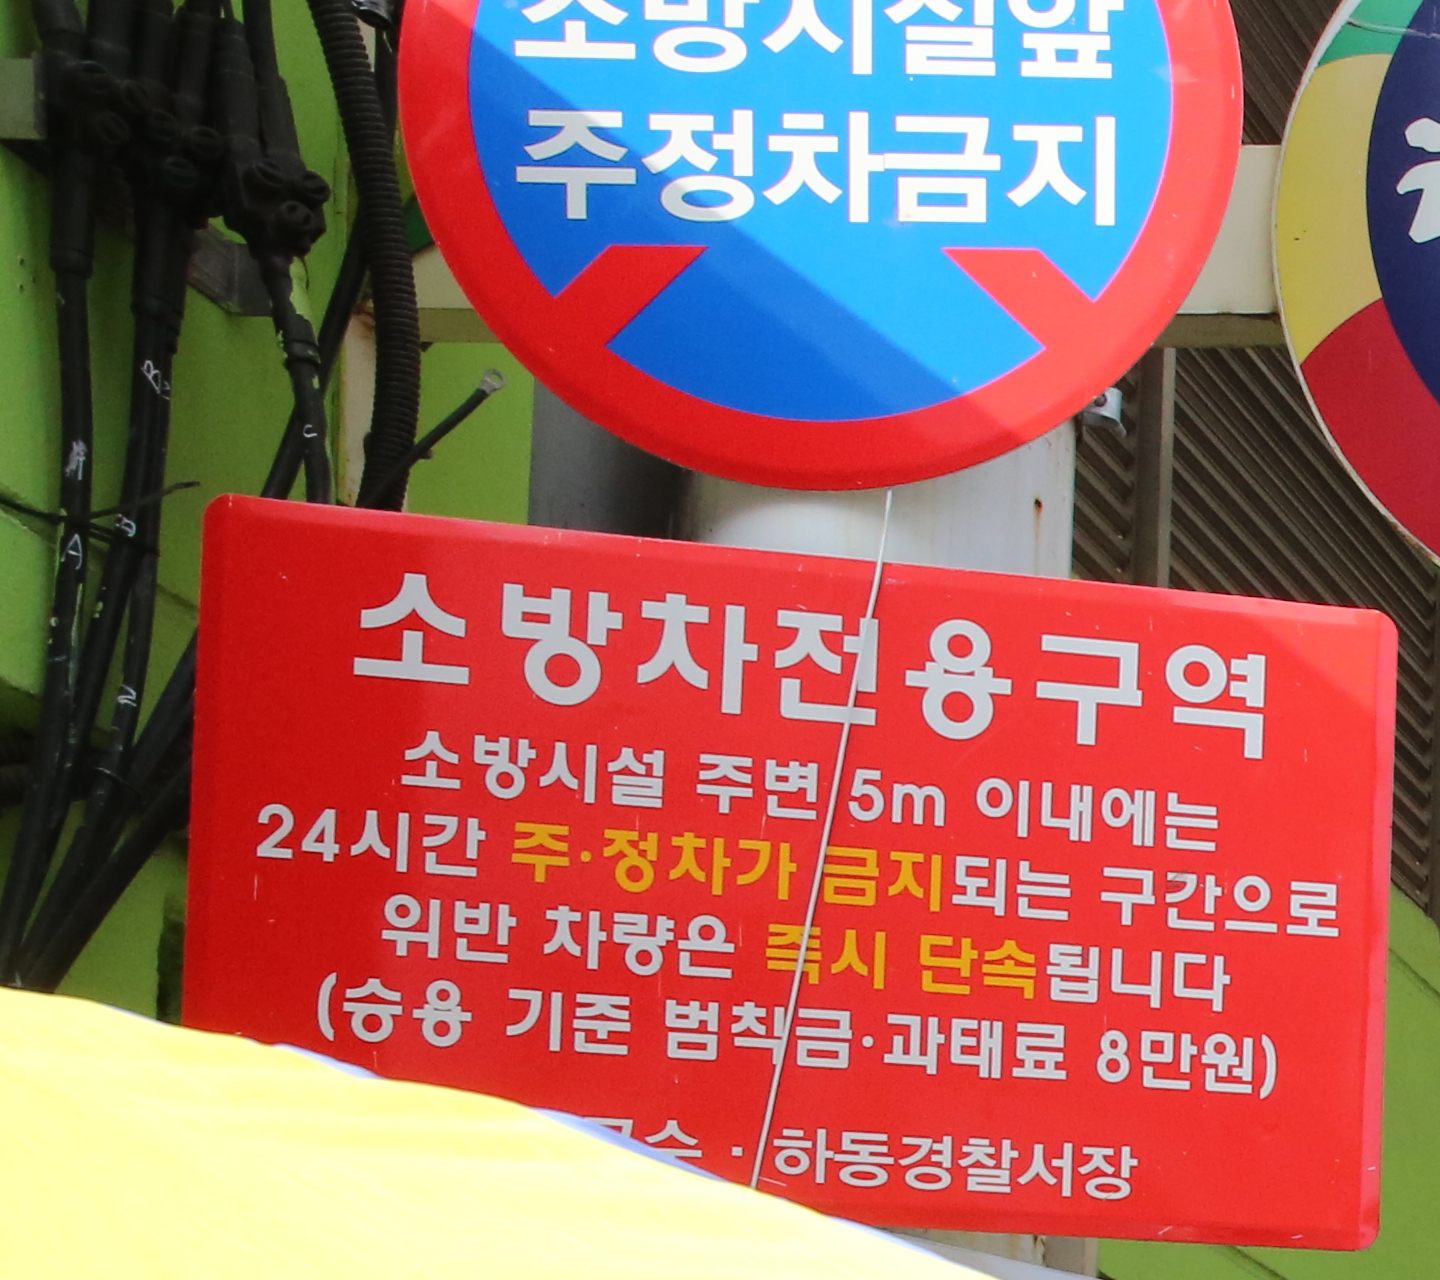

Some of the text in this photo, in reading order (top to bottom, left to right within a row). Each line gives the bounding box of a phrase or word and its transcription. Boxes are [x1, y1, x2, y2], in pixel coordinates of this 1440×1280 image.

[515, 109, 1118, 227] 주정차금지
[353, 573, 1268, 759] 소방차전용구역
[401, 730, 1220, 851] 소방시설 주변 5m 이내에는
[257, 801, 1339, 939] 24시간 주·정차가 금지되는 구간으로
[382, 895, 1231, 1012] 위반 차량은 즉시 단속됩니다
[318, 972, 1277, 1098] (승용 기준 범칙금·과태료 8만원)
[773, 1126, 1139, 1200] 하동경찰서장
